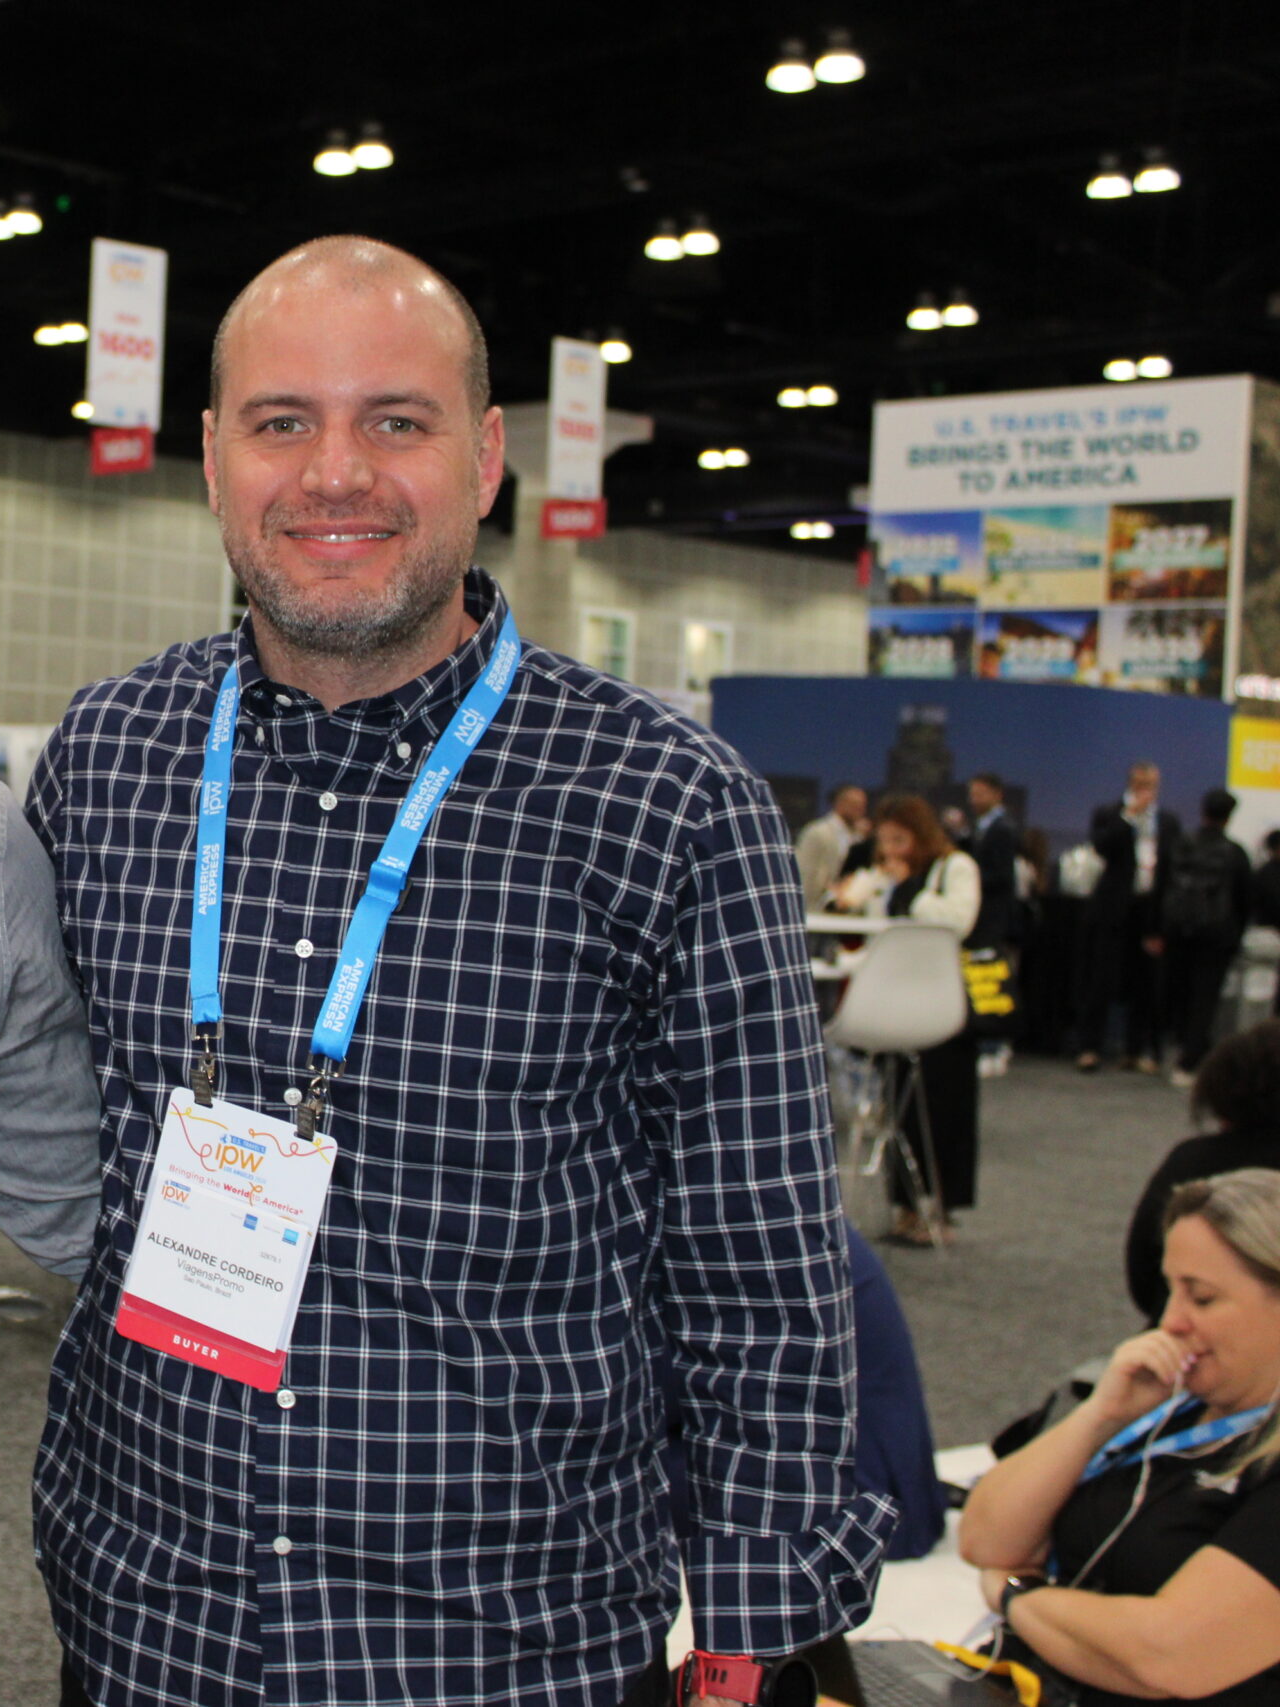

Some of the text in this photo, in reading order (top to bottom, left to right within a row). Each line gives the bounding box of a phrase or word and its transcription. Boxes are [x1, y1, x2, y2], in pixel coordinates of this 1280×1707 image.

[990, 407, 1108, 431] TRAVEL'S
[907, 428, 1200, 469] BRINGS THE WORLD
[958, 463, 1139, 492] TO AMERICA
[484, 638, 508, 688] EXPRESS
[493, 640, 517, 695] AMERICAN
[211, 688, 230, 752] AMERICAN
[221, 686, 238, 743] EXPRESS
[454, 708, 481, 743] ipw
[209, 781, 225, 815] ipw
[400, 769, 437, 830] EXPRESS
[410, 765, 451, 832] AMERICAN
[198, 844, 212, 916] AMERICAN
[207, 842, 221, 906] EXPRESS
[321, 963, 352, 1030] EXPRESS
[331, 957, 366, 1033] AMERICAN
[169, 1164, 204, 1185] Bringing
[206, 1176, 222, 1188] the
[223, 1183, 250, 1198] World
[215, 1143, 264, 1172] ipw
[161, 1184, 190, 1204] ipw
[147, 1231, 284, 1293] ALEXANDRE CORDEIRO
[177, 1258, 245, 1294] ViagensPromo
[172, 1334, 219, 1360] BUYER
